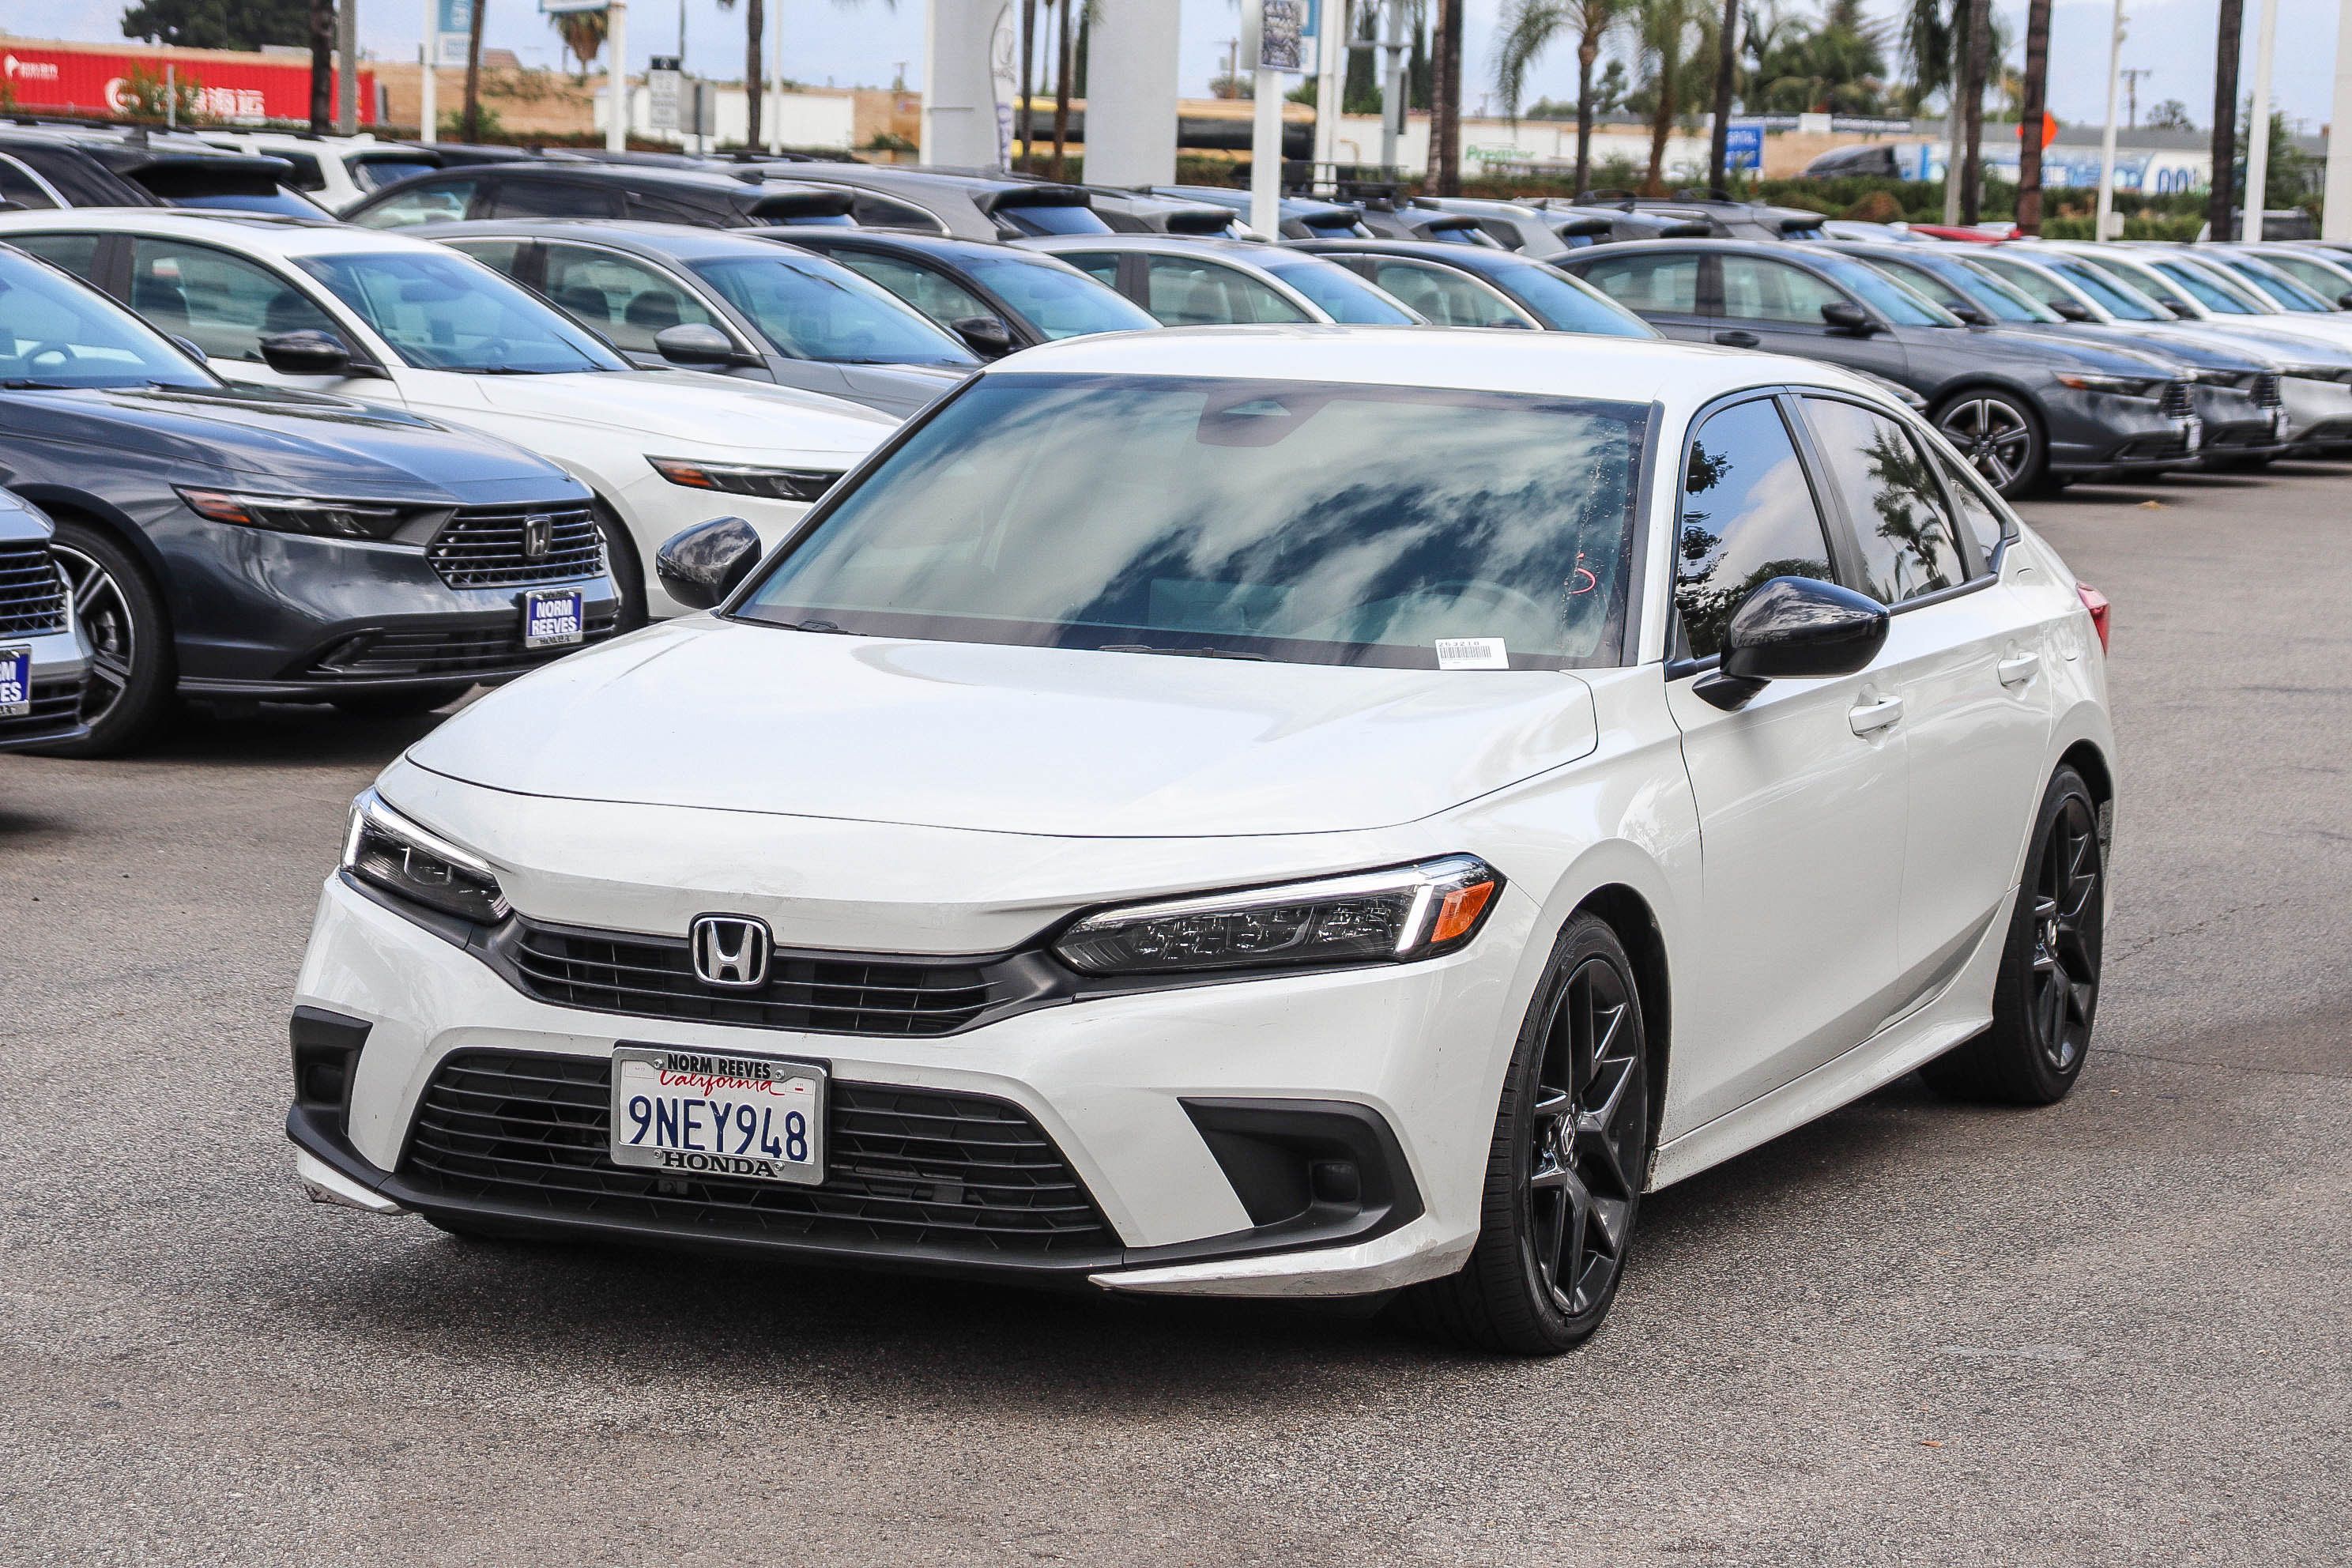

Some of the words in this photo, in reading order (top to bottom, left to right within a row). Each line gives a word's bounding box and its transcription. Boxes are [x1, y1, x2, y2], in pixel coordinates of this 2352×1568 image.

[536, 599, 574, 618] NORM
[531, 616, 578, 636] REEVES
[667, 1053, 713, 1074] NORM
[718, 1057, 771, 1080] REEVES
[659, 1069, 786, 1097] California
[628, 1095, 808, 1162] 9NEY948
[662, 1149, 778, 1178] HONDA
